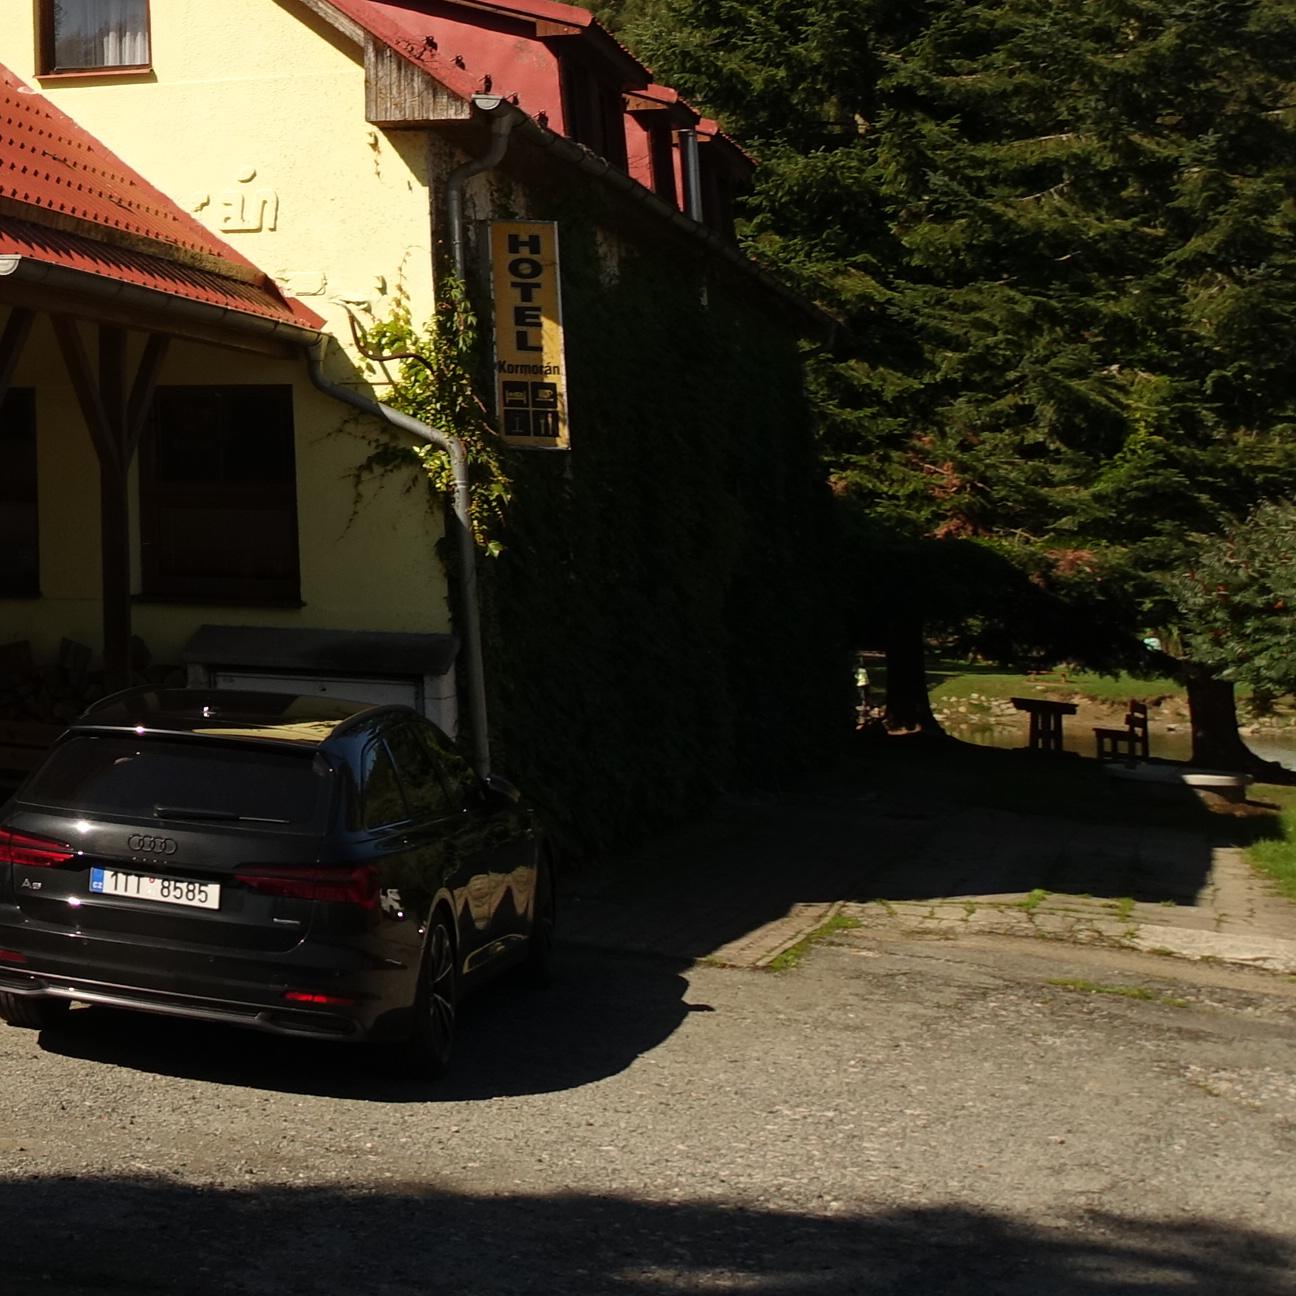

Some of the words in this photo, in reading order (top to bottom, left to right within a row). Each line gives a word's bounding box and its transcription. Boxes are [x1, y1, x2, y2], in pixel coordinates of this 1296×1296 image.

[508, 234, 543, 352] HOTEL
[497, 360, 560, 375] Kormorán
[92, 881, 103, 890] CZ
[160, 879, 209, 903] 8585
